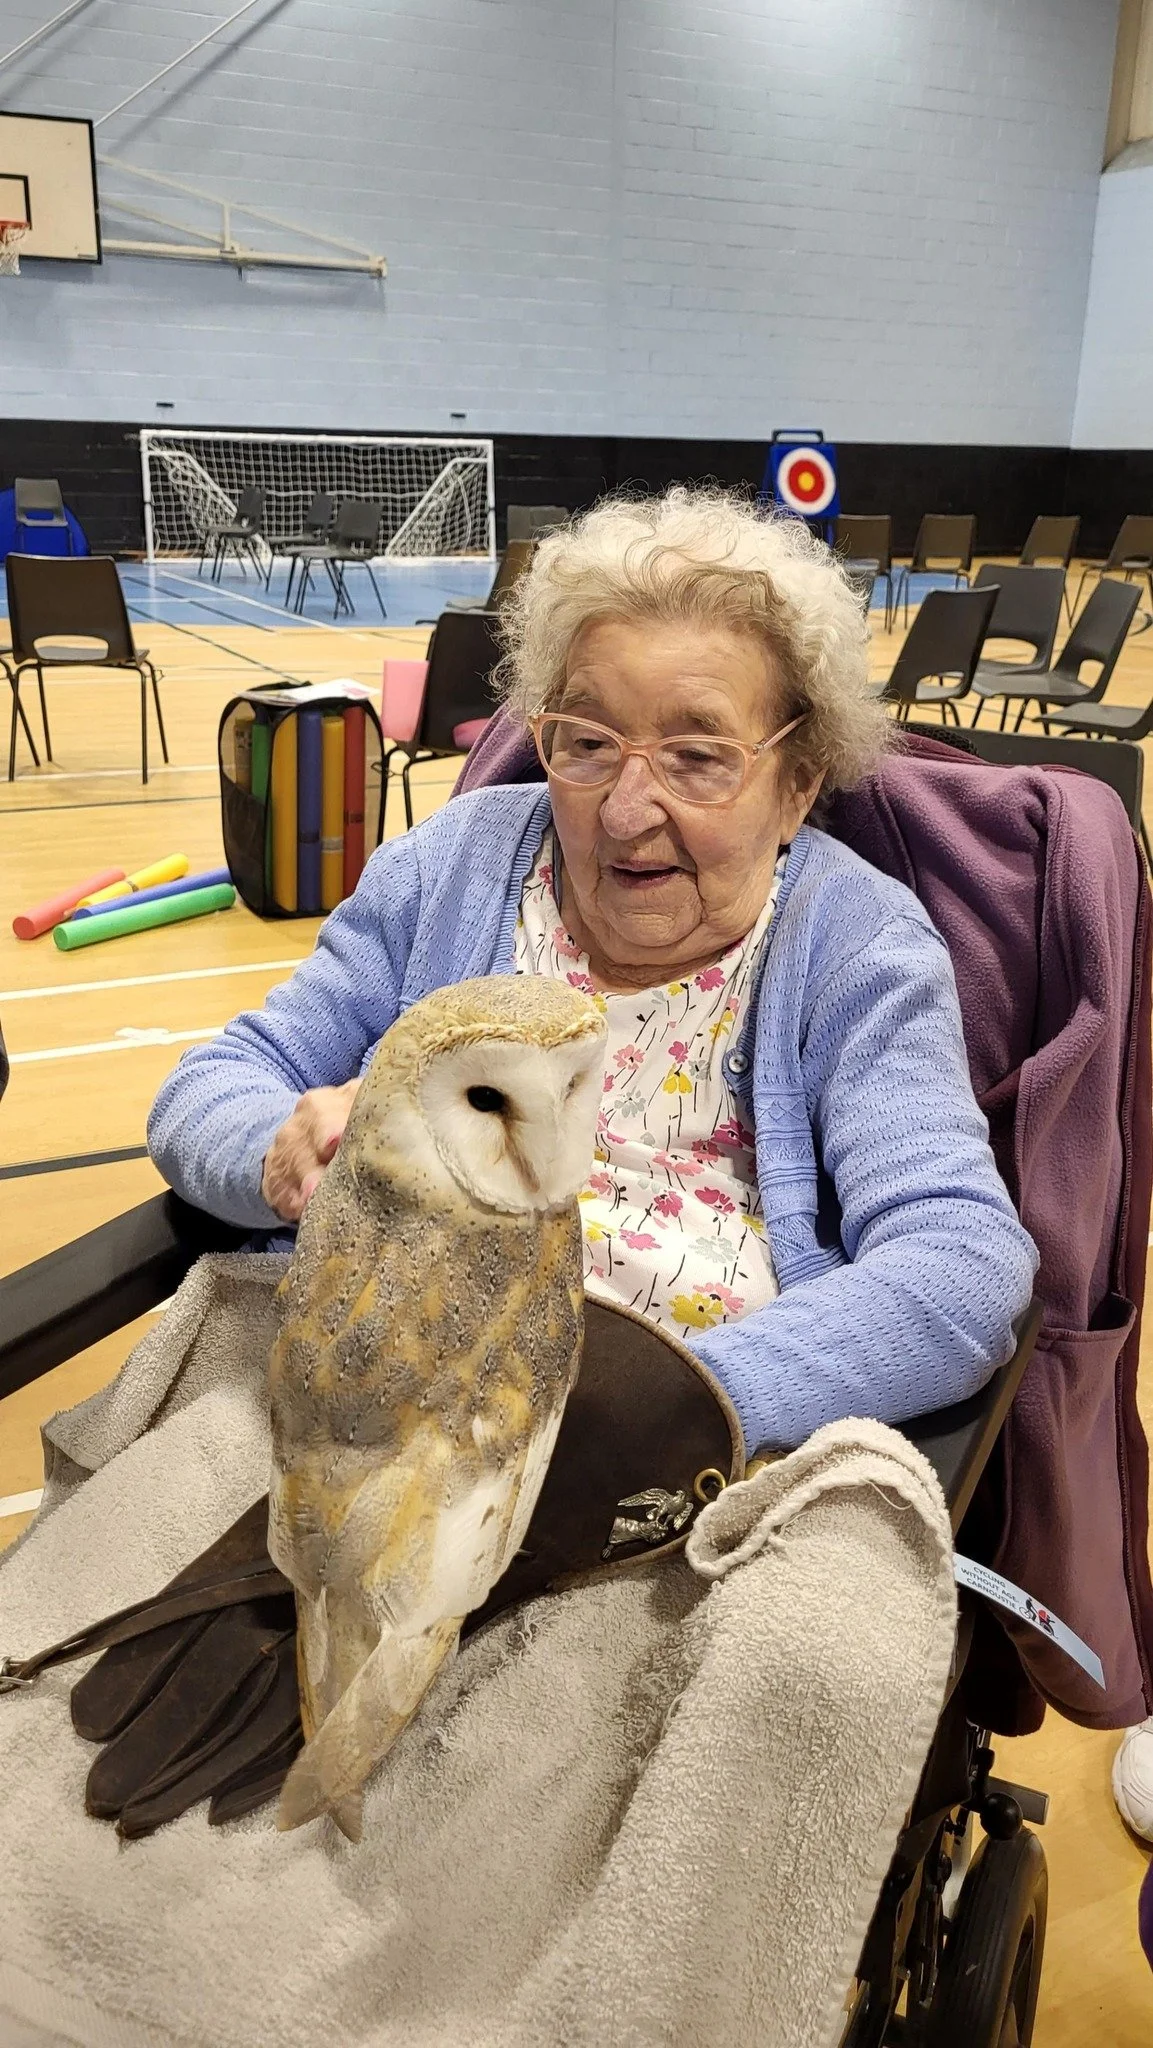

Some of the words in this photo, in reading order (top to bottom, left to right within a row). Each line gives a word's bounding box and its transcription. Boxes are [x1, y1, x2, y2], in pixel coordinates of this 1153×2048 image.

[960, 1567, 999, 1591] WITHOUT
[973, 1566, 1006, 1588] CYCLING
[966, 1578, 1017, 1609] CARNOUSTIE
